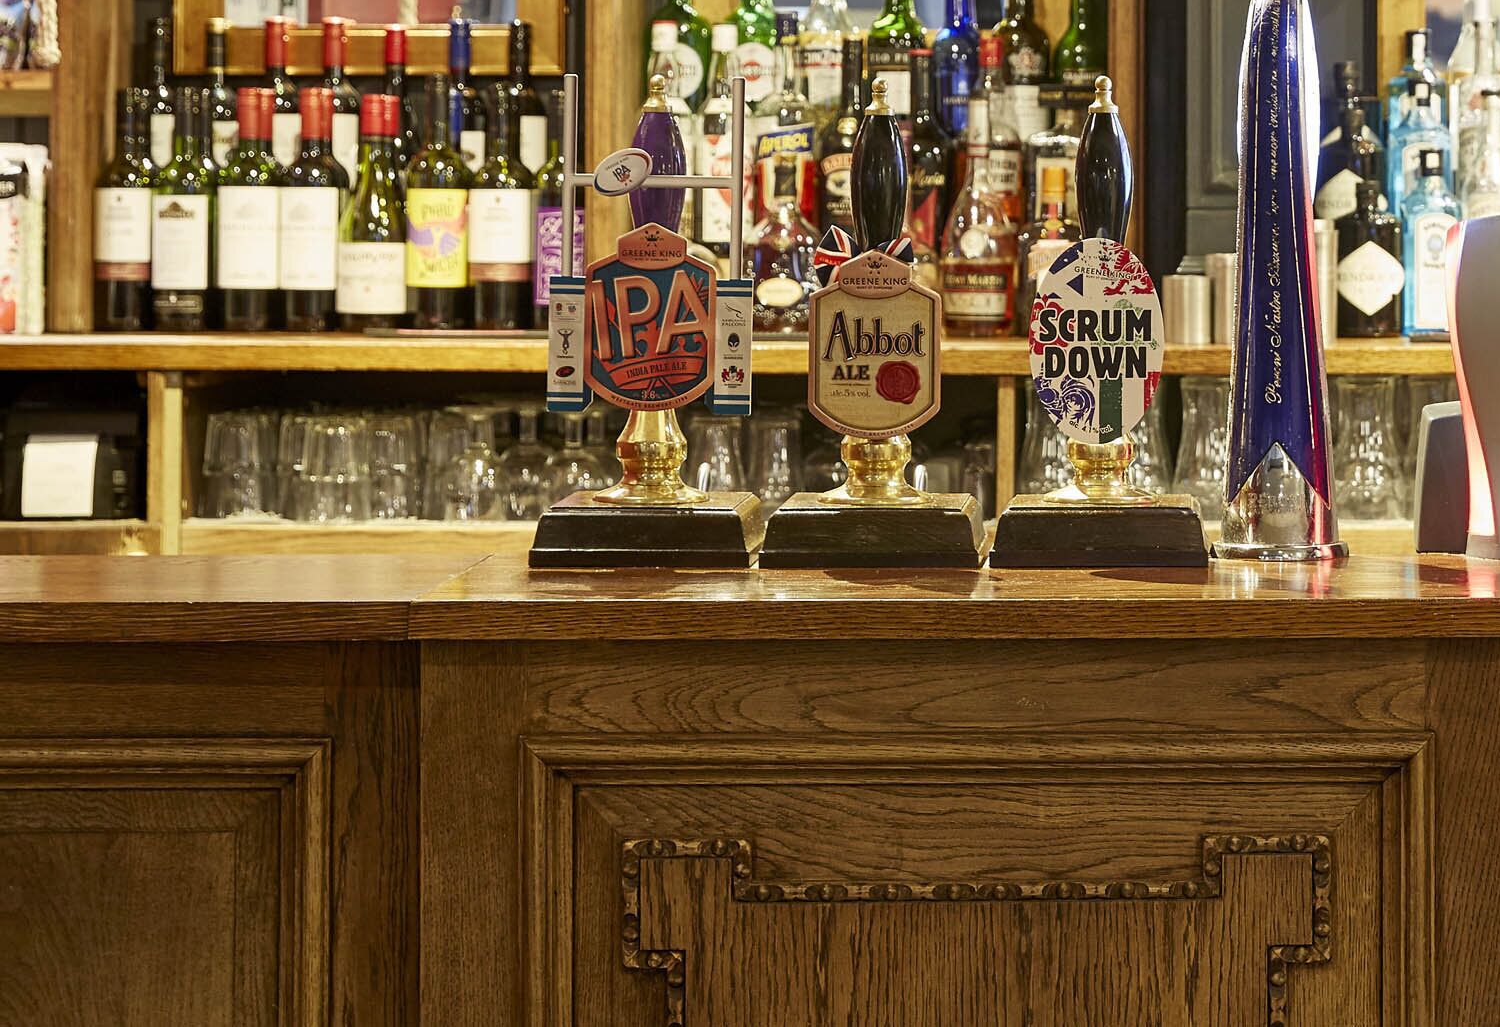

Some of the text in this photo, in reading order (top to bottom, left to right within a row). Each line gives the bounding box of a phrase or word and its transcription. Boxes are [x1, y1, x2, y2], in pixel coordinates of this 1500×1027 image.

[759, 132, 810, 155] APEROL
[612, 164, 632, 182] IPA
[621, 249, 657, 257] GREENE
[842, 277, 908, 286] GREENE KING
[1074, 266, 1108, 276] GREENE
[1111, 271, 1132, 280] KING
[591, 270, 711, 361] IPA
[1039, 310, 1152, 342] SCRUM
[1263, 289, 1282, 347] Nastro
[822, 310, 926, 362] Abbot
[626, 361, 687, 378] INDIA PALE ALE
[831, 364, 870, 380] ALE
[1044, 346, 1147, 379] DOWN
[1264, 350, 1282, 403] Peroni
